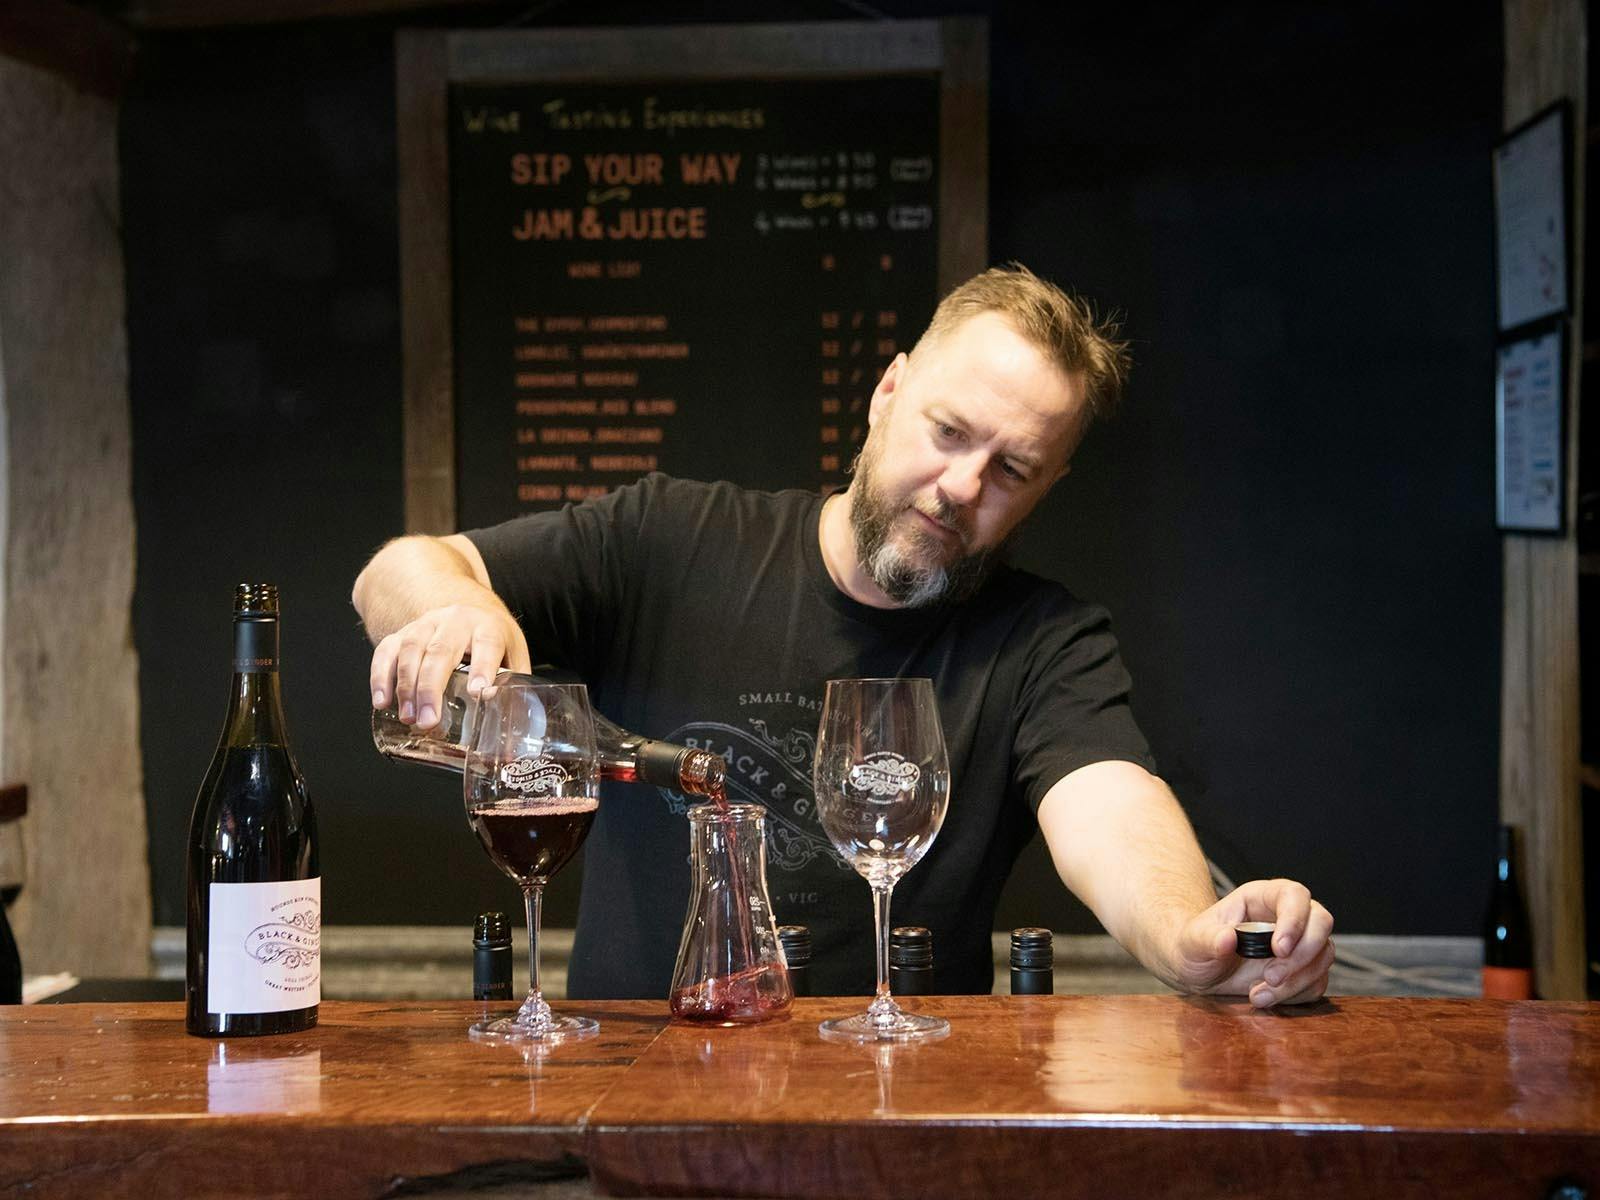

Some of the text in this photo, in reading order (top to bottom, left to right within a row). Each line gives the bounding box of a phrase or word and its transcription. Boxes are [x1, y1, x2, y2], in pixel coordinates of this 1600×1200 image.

[510, 153, 572, 186] SIP
[583, 153, 664, 186] YOUR
[679, 153, 742, 186] WAY
[738, 692, 793, 706] SMALL
[684, 737, 770, 785] BLACK
[771, 783, 788, 800] &
[788, 891, 818, 905] VIC
[258, 930, 293, 942] BLACK
